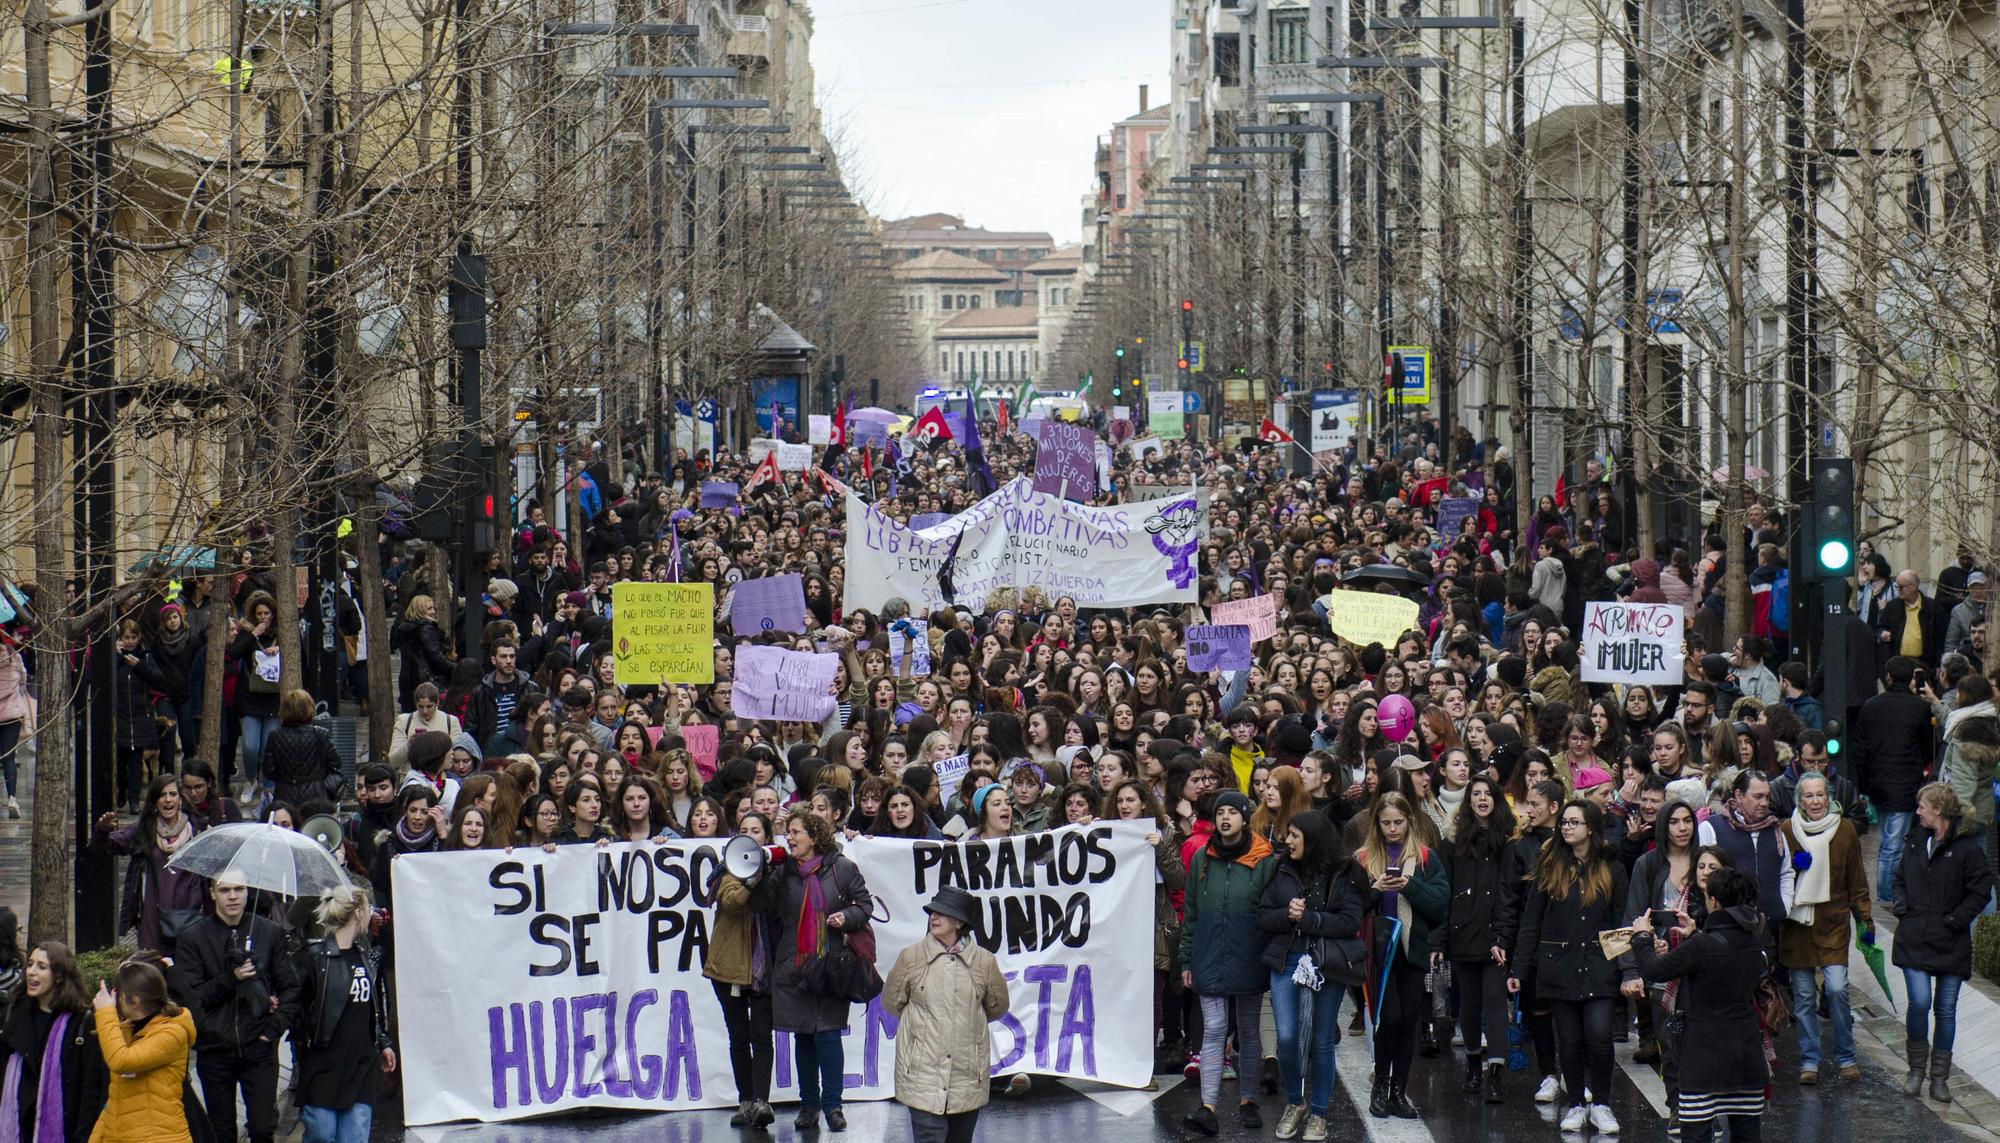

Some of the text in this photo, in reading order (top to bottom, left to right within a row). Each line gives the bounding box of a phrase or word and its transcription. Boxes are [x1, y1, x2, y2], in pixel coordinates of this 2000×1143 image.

[1404, 375, 1421, 384] AXI
[1047, 423, 1080, 440] 3700
[1040, 438, 1094, 463] MILLONES
[1057, 450, 1074, 465] DE
[1035, 463, 1093, 493] MUJERES
[667, 590, 702, 604] MACHO
[623, 608, 637, 620] NO
[1827, 603, 1842, 615] 12
[630, 623, 707, 636] AL PISAR LA FLOR
[1187, 624, 1245, 641] CALLADITA
[634, 643, 651, 656] LAS
[1188, 641, 1210, 657] NO
[935, 763, 943, 775] 8
[488, 861, 546, 915] SI
[912, 827, 1117, 895] PARAMOS
[528, 912, 602, 977] SE
[972, 891, 1091, 955] UNDO
[349, 976, 371, 1003] 48
[487, 988, 703, 1108] HUELGA
